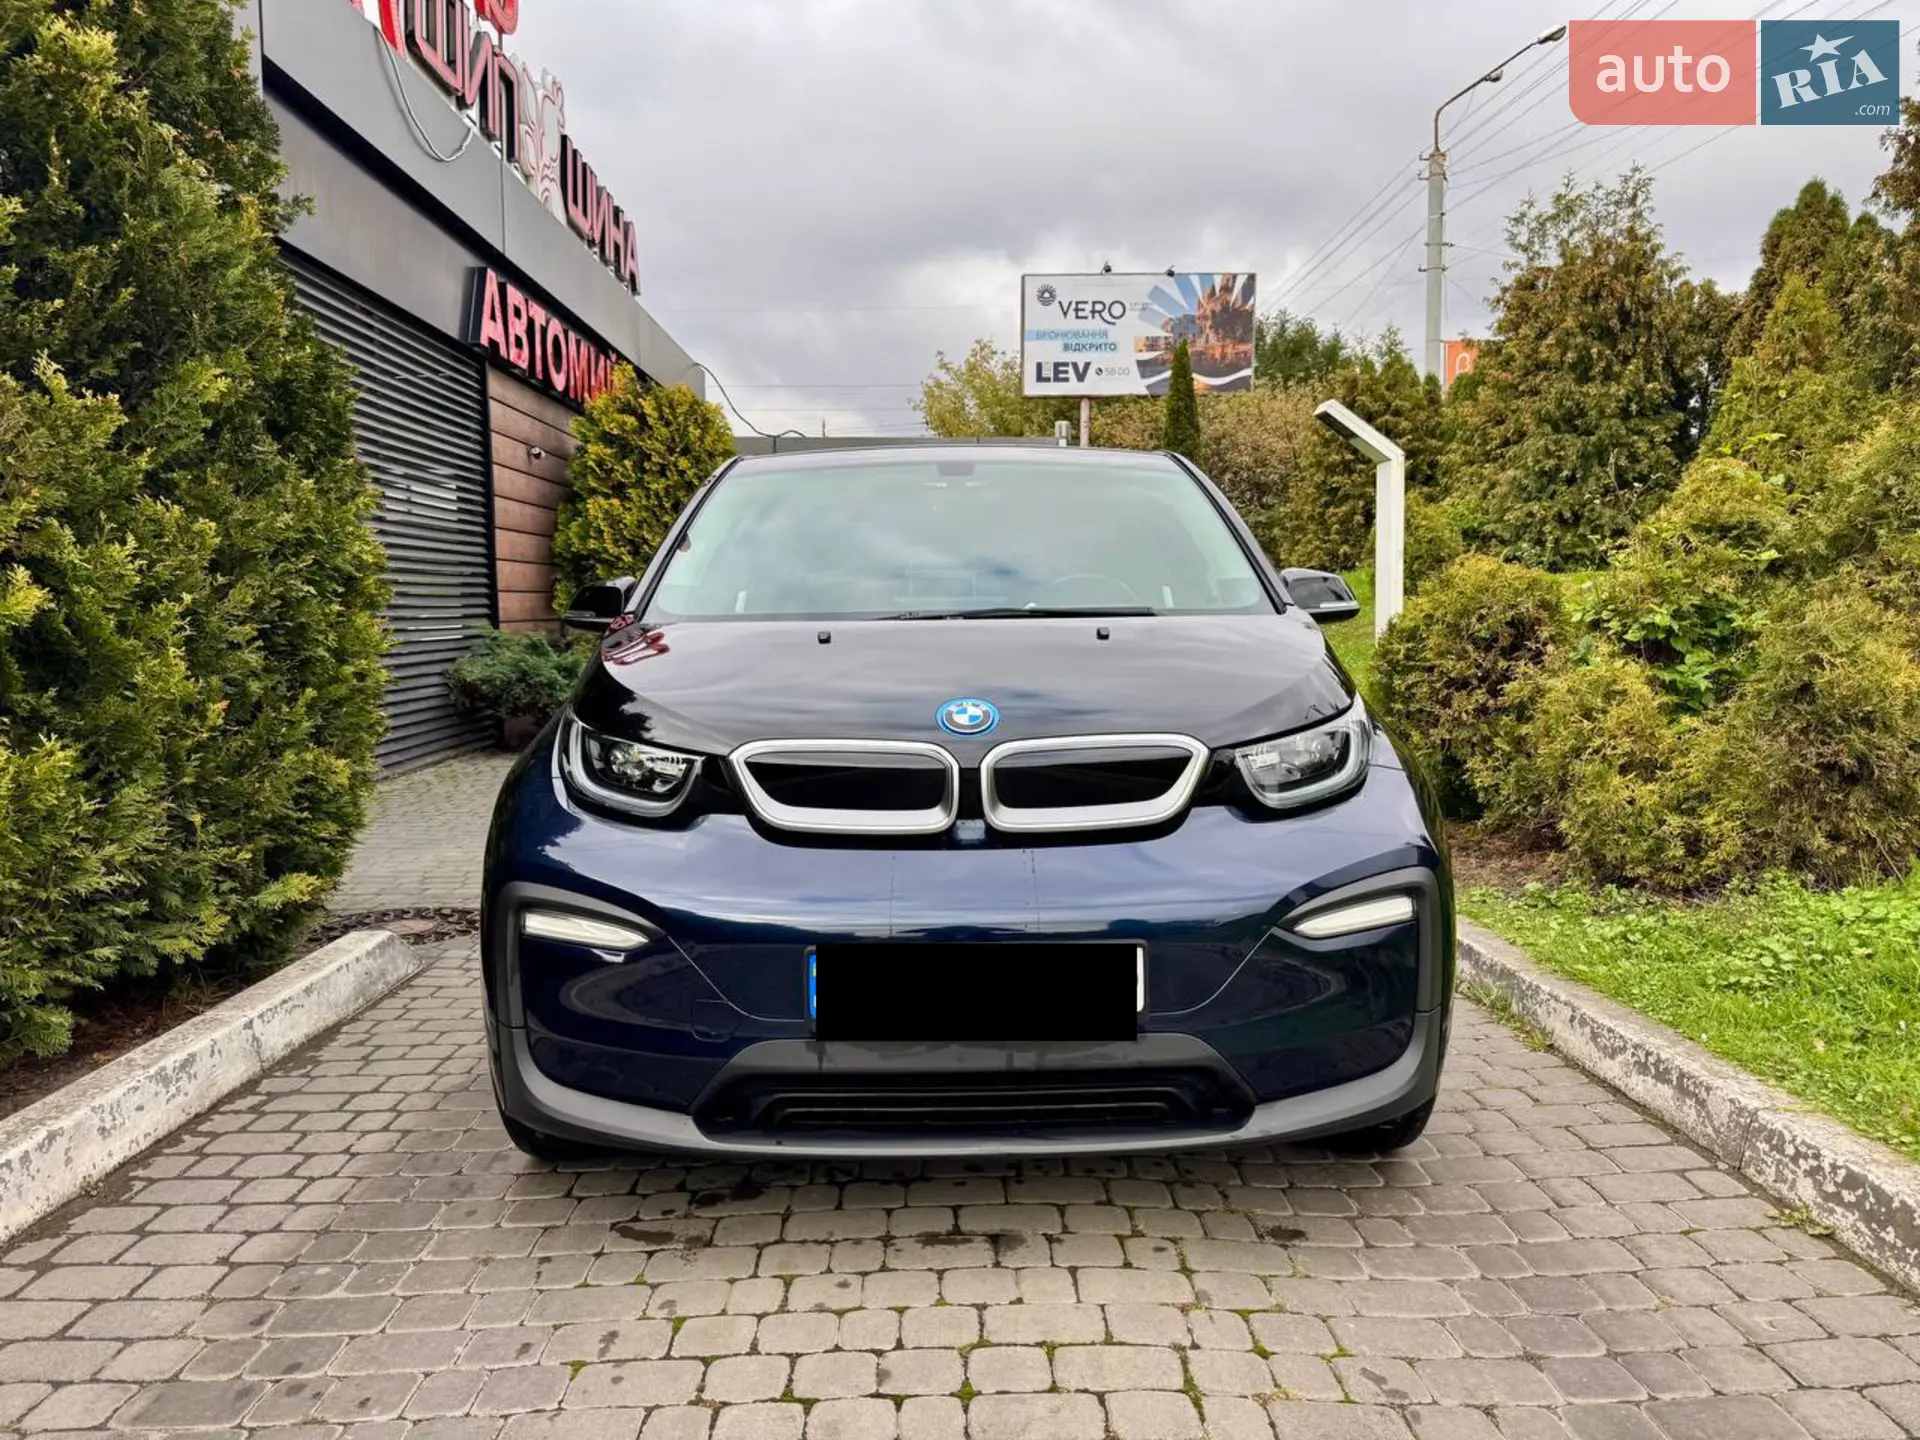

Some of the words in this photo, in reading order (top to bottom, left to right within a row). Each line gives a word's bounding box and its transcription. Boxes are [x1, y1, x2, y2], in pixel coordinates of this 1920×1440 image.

[562, 135, 641, 295] ШИНА
[1058, 300, 1127, 326] VERO
[1063, 342, 1117, 353] ВІДКРИТО
[1035, 361, 1092, 383] LEV
